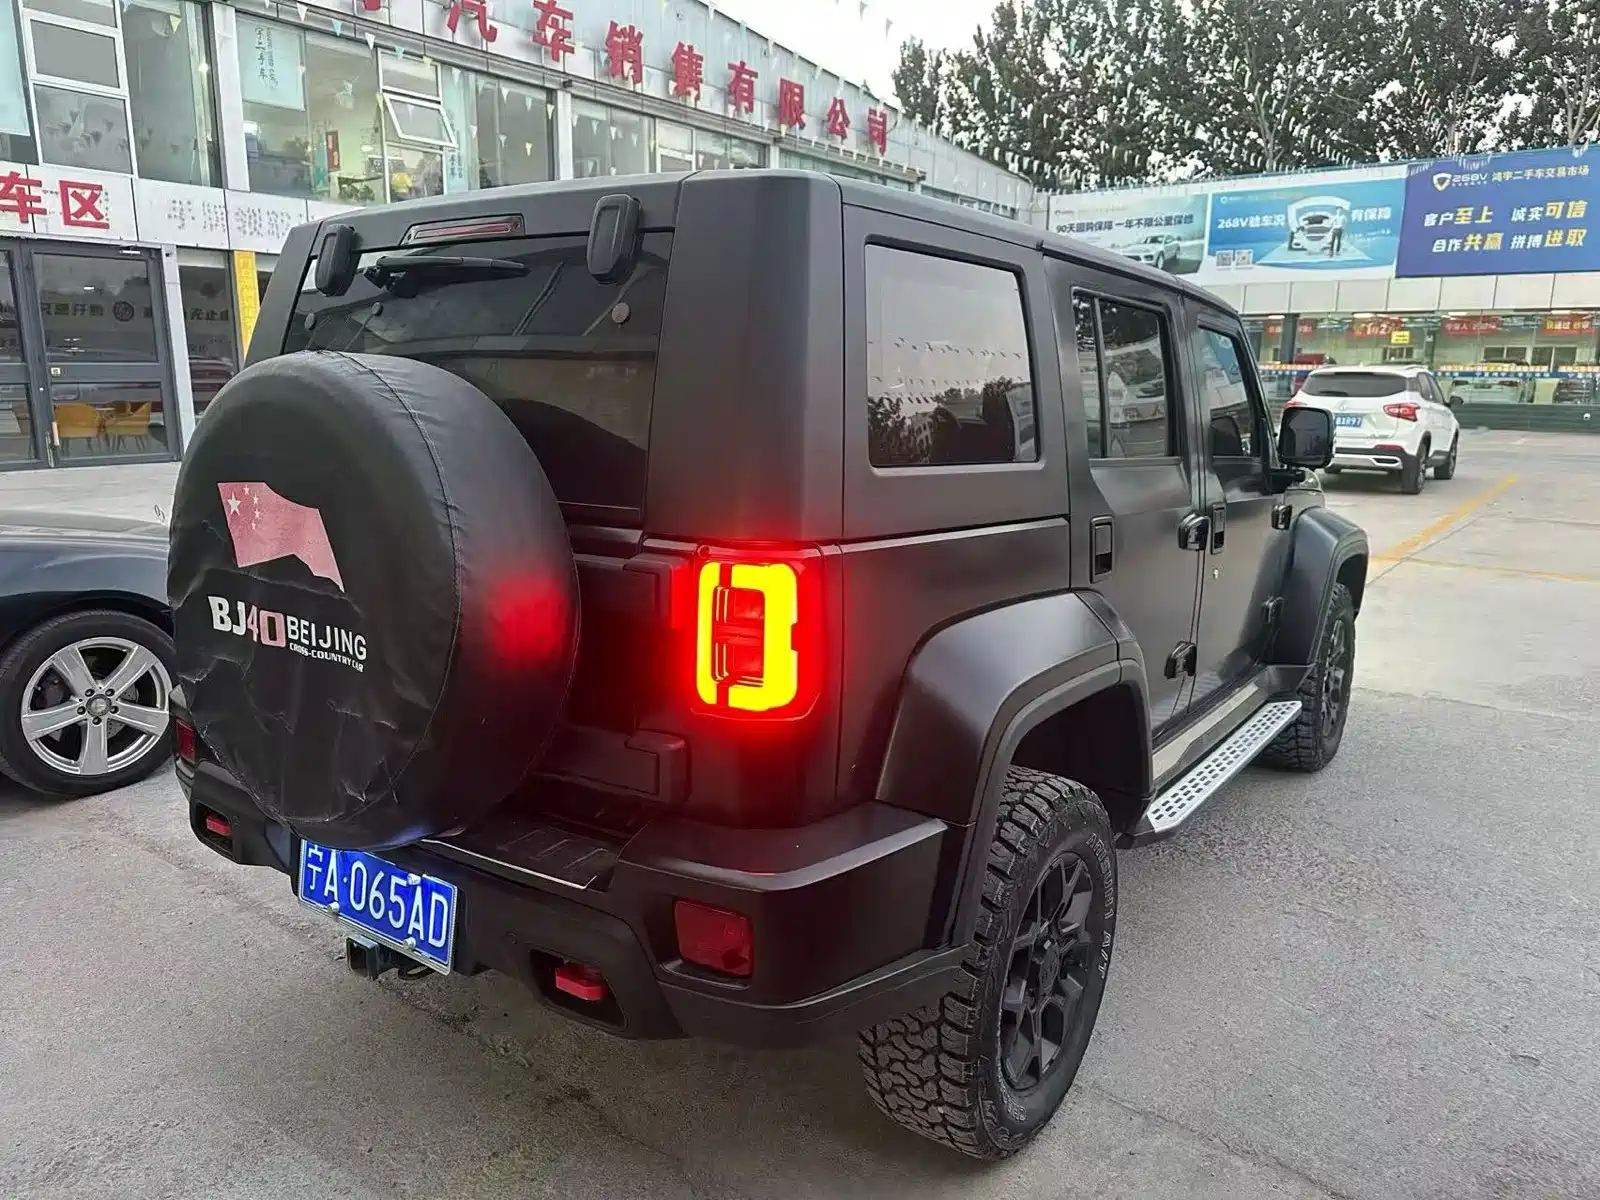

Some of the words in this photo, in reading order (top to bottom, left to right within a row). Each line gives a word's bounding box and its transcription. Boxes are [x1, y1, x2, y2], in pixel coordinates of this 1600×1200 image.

[363, 0, 888, 157] 汽车销售有限公司
[1351, 206, 1392, 222] 有保障
[1423, 206, 1494, 226] 客户至上
[1511, 200, 1588, 221] 诚实可信
[1432, 232, 1504, 252] 合作共赢
[1510, 228, 1587, 249] 拼搏进取
[208, 596, 286, 648] BJ40
[287, 615, 367, 661] BEIJING
[289, 642, 352, 666] CROSS-COUNTRY
